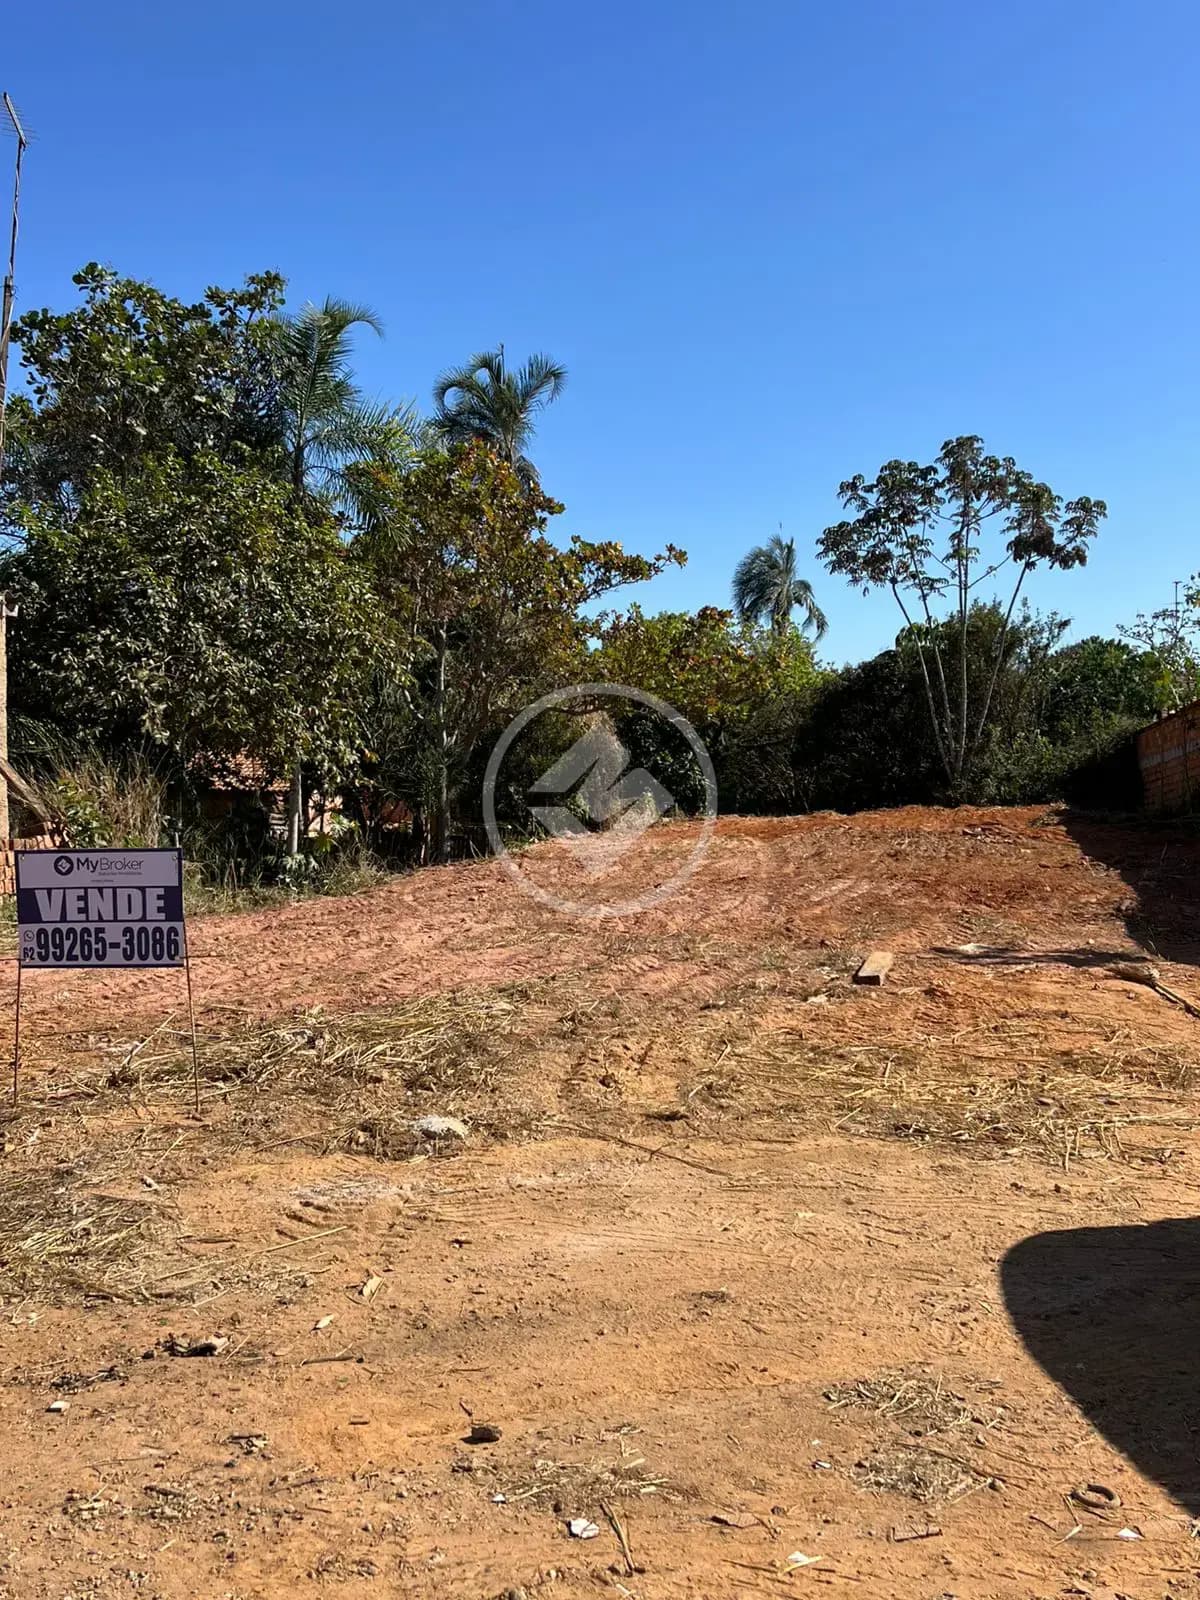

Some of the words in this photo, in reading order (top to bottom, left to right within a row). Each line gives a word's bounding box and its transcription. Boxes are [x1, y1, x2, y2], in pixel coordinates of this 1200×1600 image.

[76, 857, 144, 873] MyBroker
[35, 888, 166, 922] VENDE
[36, 926, 179, 962] 99265-3086
